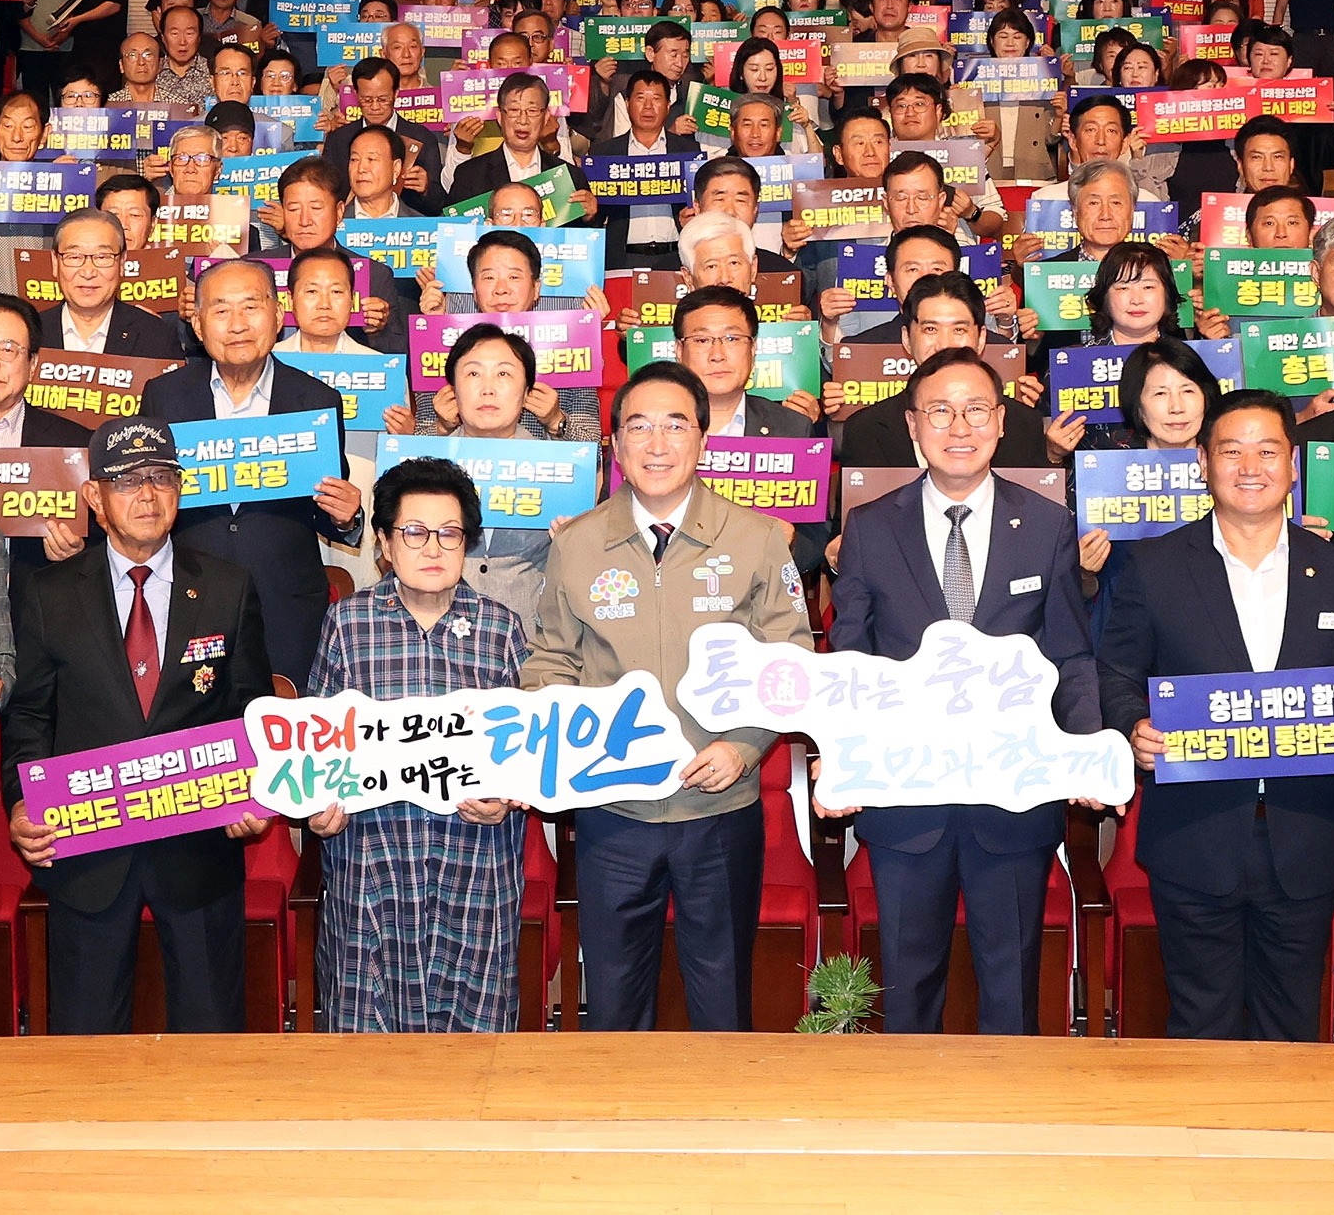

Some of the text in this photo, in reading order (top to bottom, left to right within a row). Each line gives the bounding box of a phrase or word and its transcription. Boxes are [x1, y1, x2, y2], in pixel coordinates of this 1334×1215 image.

[1153, 96, 1246, 117] 충남 미래항공산업
[1154, 112, 1247, 135] 중심도시 태안
[35, 168, 63, 190] 함께
[12, 189, 63, 210] 통합본사
[64, 190, 90, 209] 유치
[2, 489, 77, 519] 20주년
[597, 604, 635, 618] 충청남도
[694, 597, 732, 610] 태안군
[923, 645, 1043, 716] 충남
[1208, 685, 1306, 723] 충남·태안
[260, 705, 475, 752] 미래가 모이고
[484, 687, 677, 799] 태안
[1164, 726, 1269, 763] 발전공기업
[67, 738, 237, 794] 충남 관광의 미래
[268, 753, 481, 805] 사람이 머무는
[832, 727, 1118, 797] 도민과 함께
[43, 800, 122, 838] 안면도
